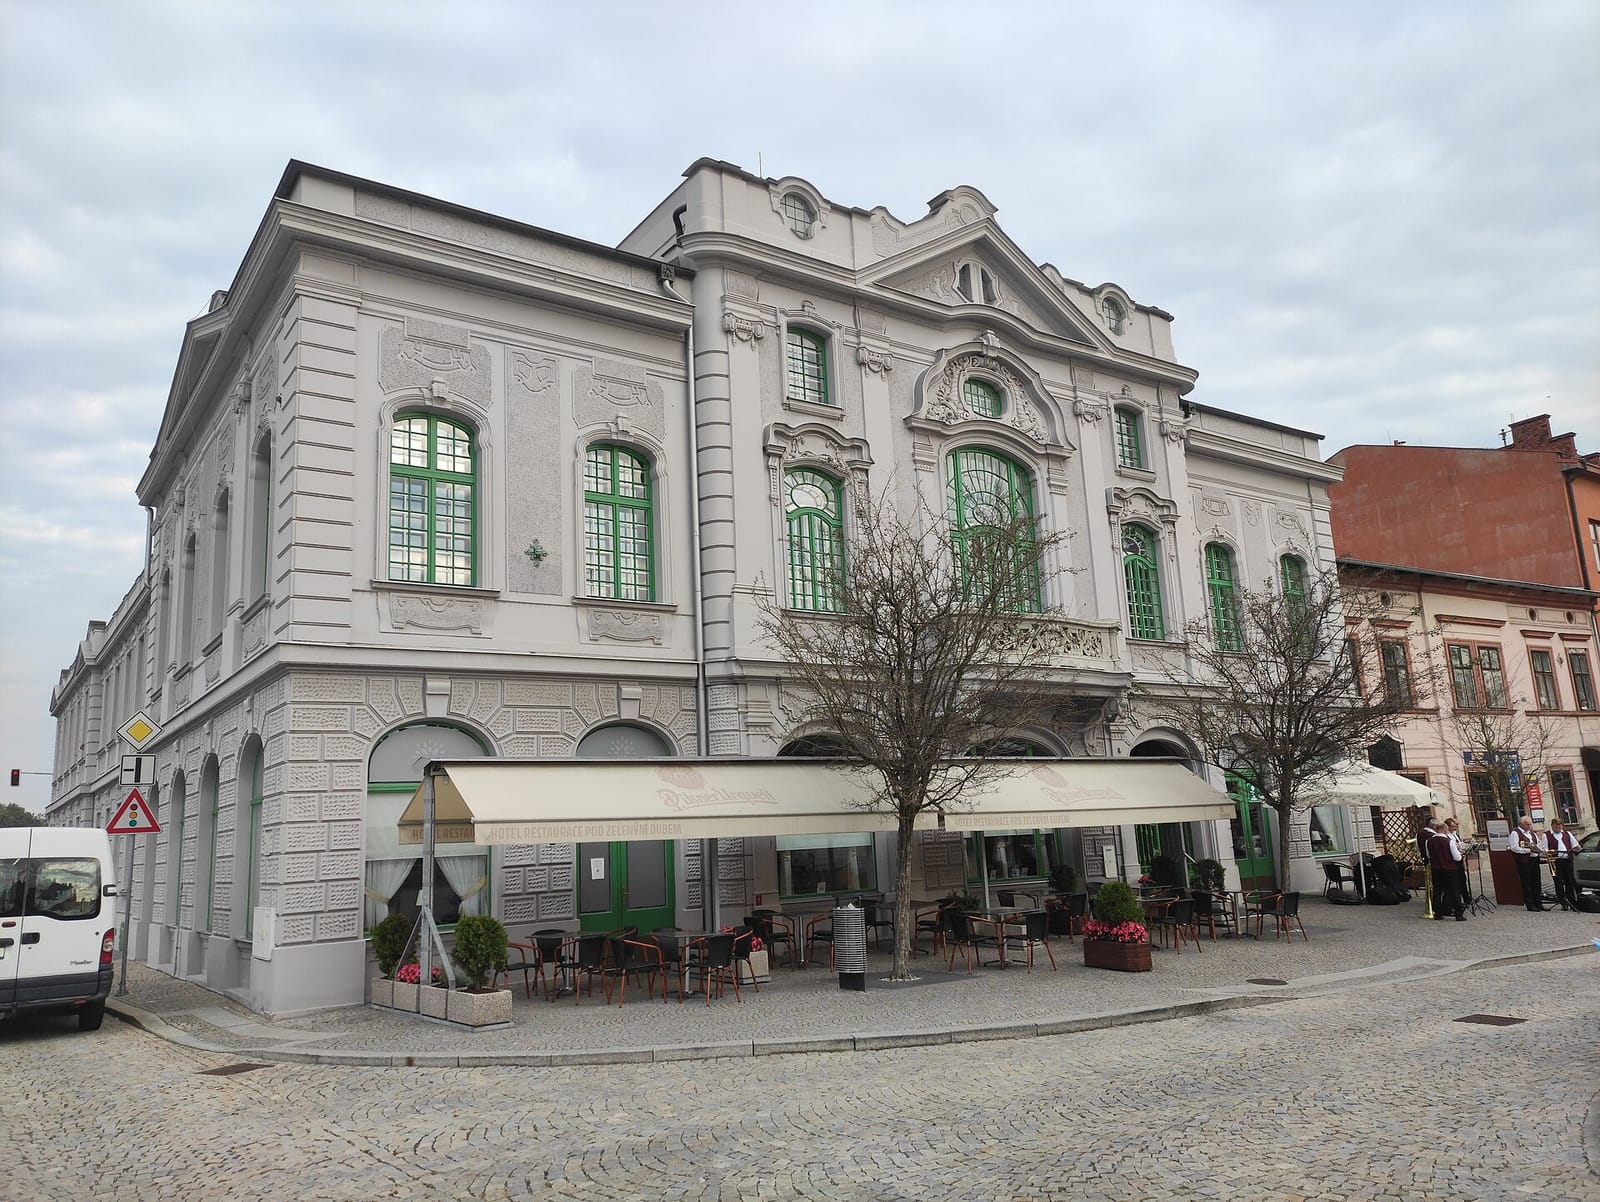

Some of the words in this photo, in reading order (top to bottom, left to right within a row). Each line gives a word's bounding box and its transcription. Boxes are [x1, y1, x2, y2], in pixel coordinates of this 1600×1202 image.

[490, 826, 522, 841] HOTEL
[523, 825, 584, 840] RESTAURACE
[585, 824, 604, 837] POD
[650, 823, 682, 836] DUBEM
